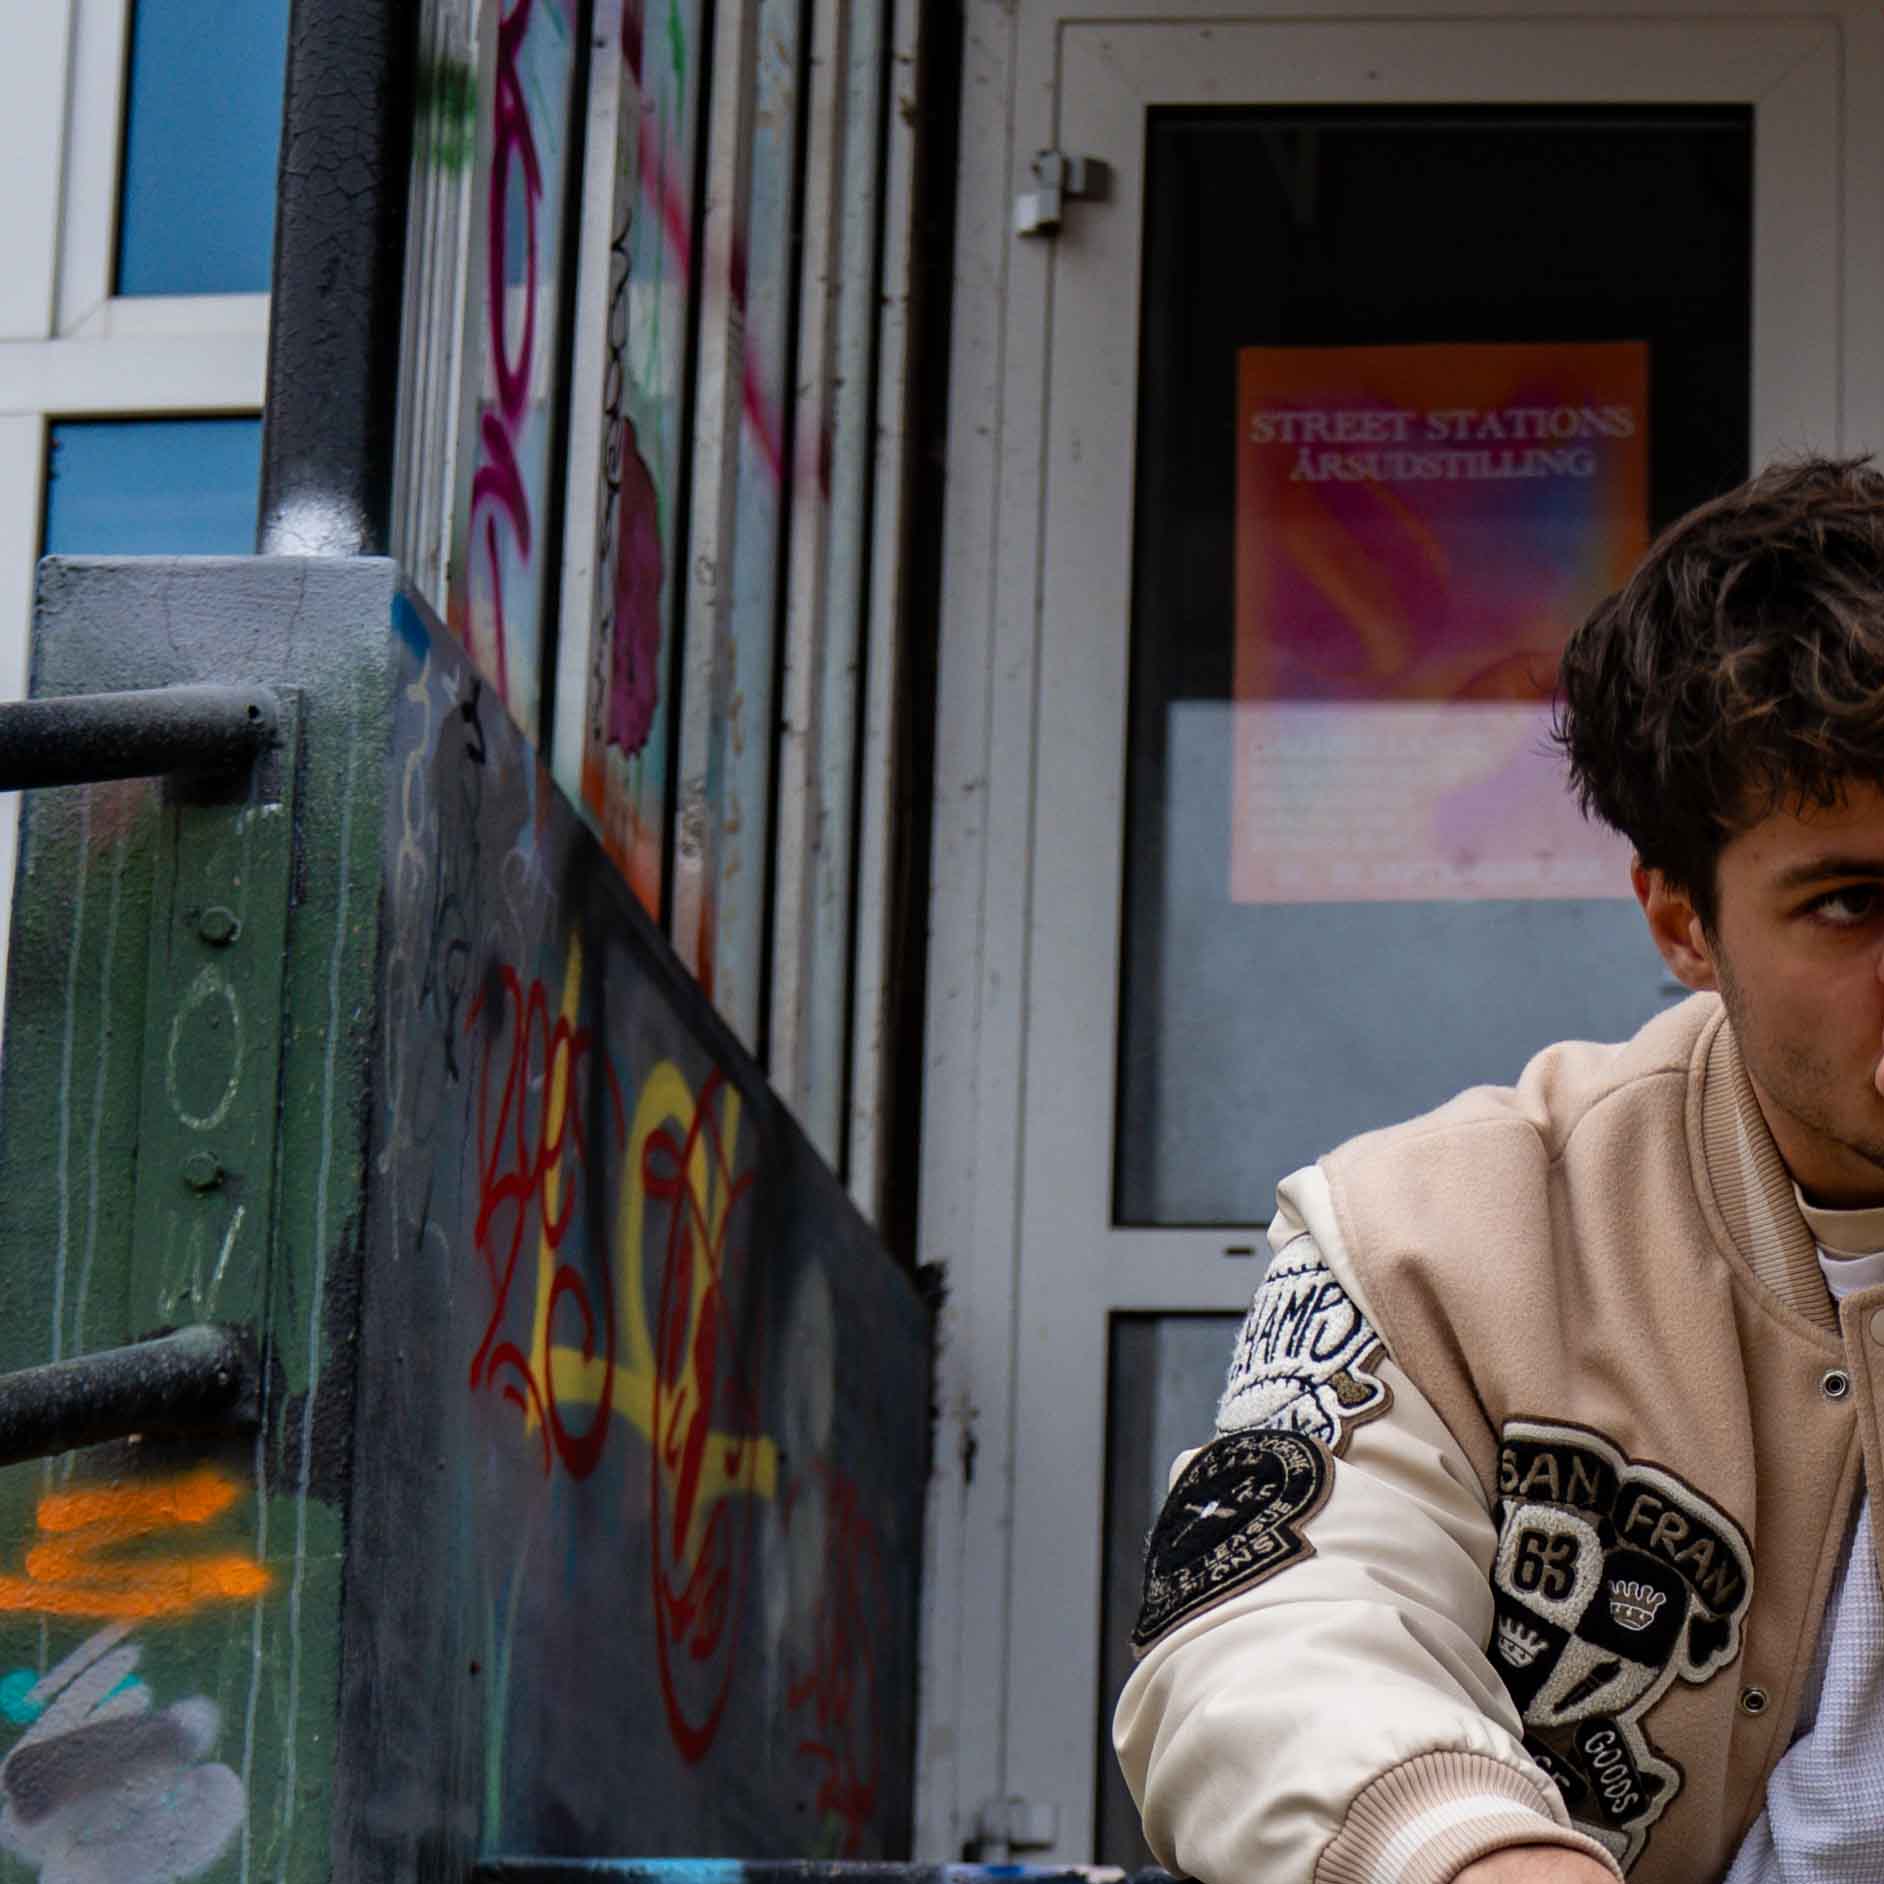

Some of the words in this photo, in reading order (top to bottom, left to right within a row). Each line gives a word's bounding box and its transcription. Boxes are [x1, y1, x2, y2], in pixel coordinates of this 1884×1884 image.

[1248, 408, 1415, 443] STREET
[1424, 404, 1636, 442] STATIONS
[1290, 445, 1596, 481] ÅRSUDSTILLING
[1501, 1449, 1600, 1503] SAN
[1624, 1494, 1741, 1616] FRAN
[1513, 1527, 1579, 1602] 63
[1584, 1729, 1639, 1815] GOODS
